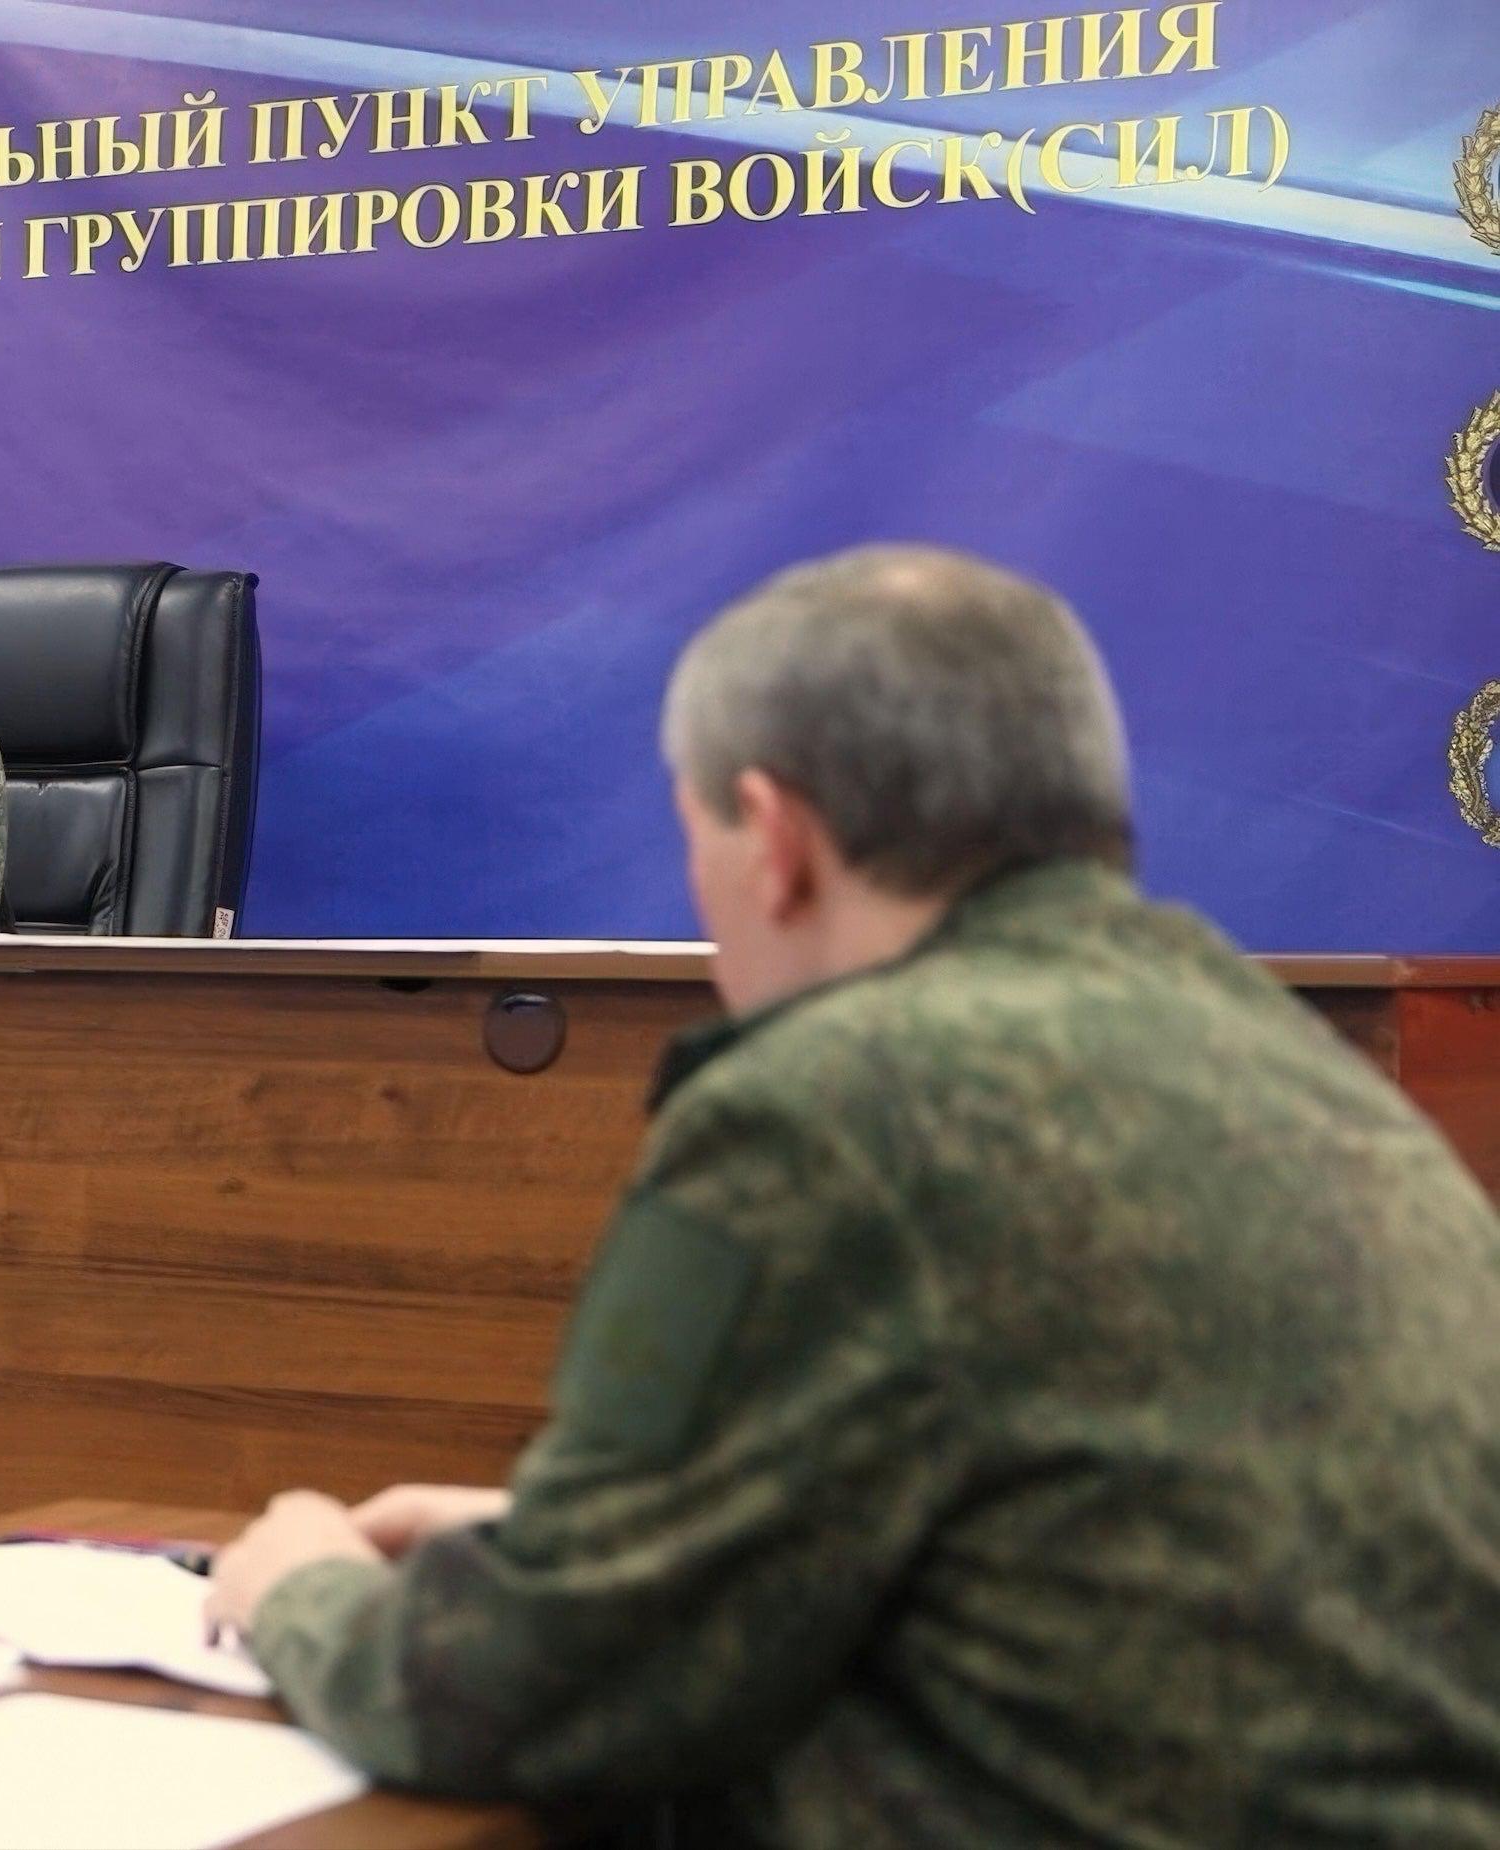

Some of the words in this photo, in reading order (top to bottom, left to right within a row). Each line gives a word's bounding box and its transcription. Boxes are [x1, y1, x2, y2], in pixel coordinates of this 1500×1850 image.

[249, 75, 548, 163] ПУНКТ
[574, 1, 1222, 134] УПРАВЛЕНИЯ
[22, 165, 646, 278] ГРУППИРОВКИ
